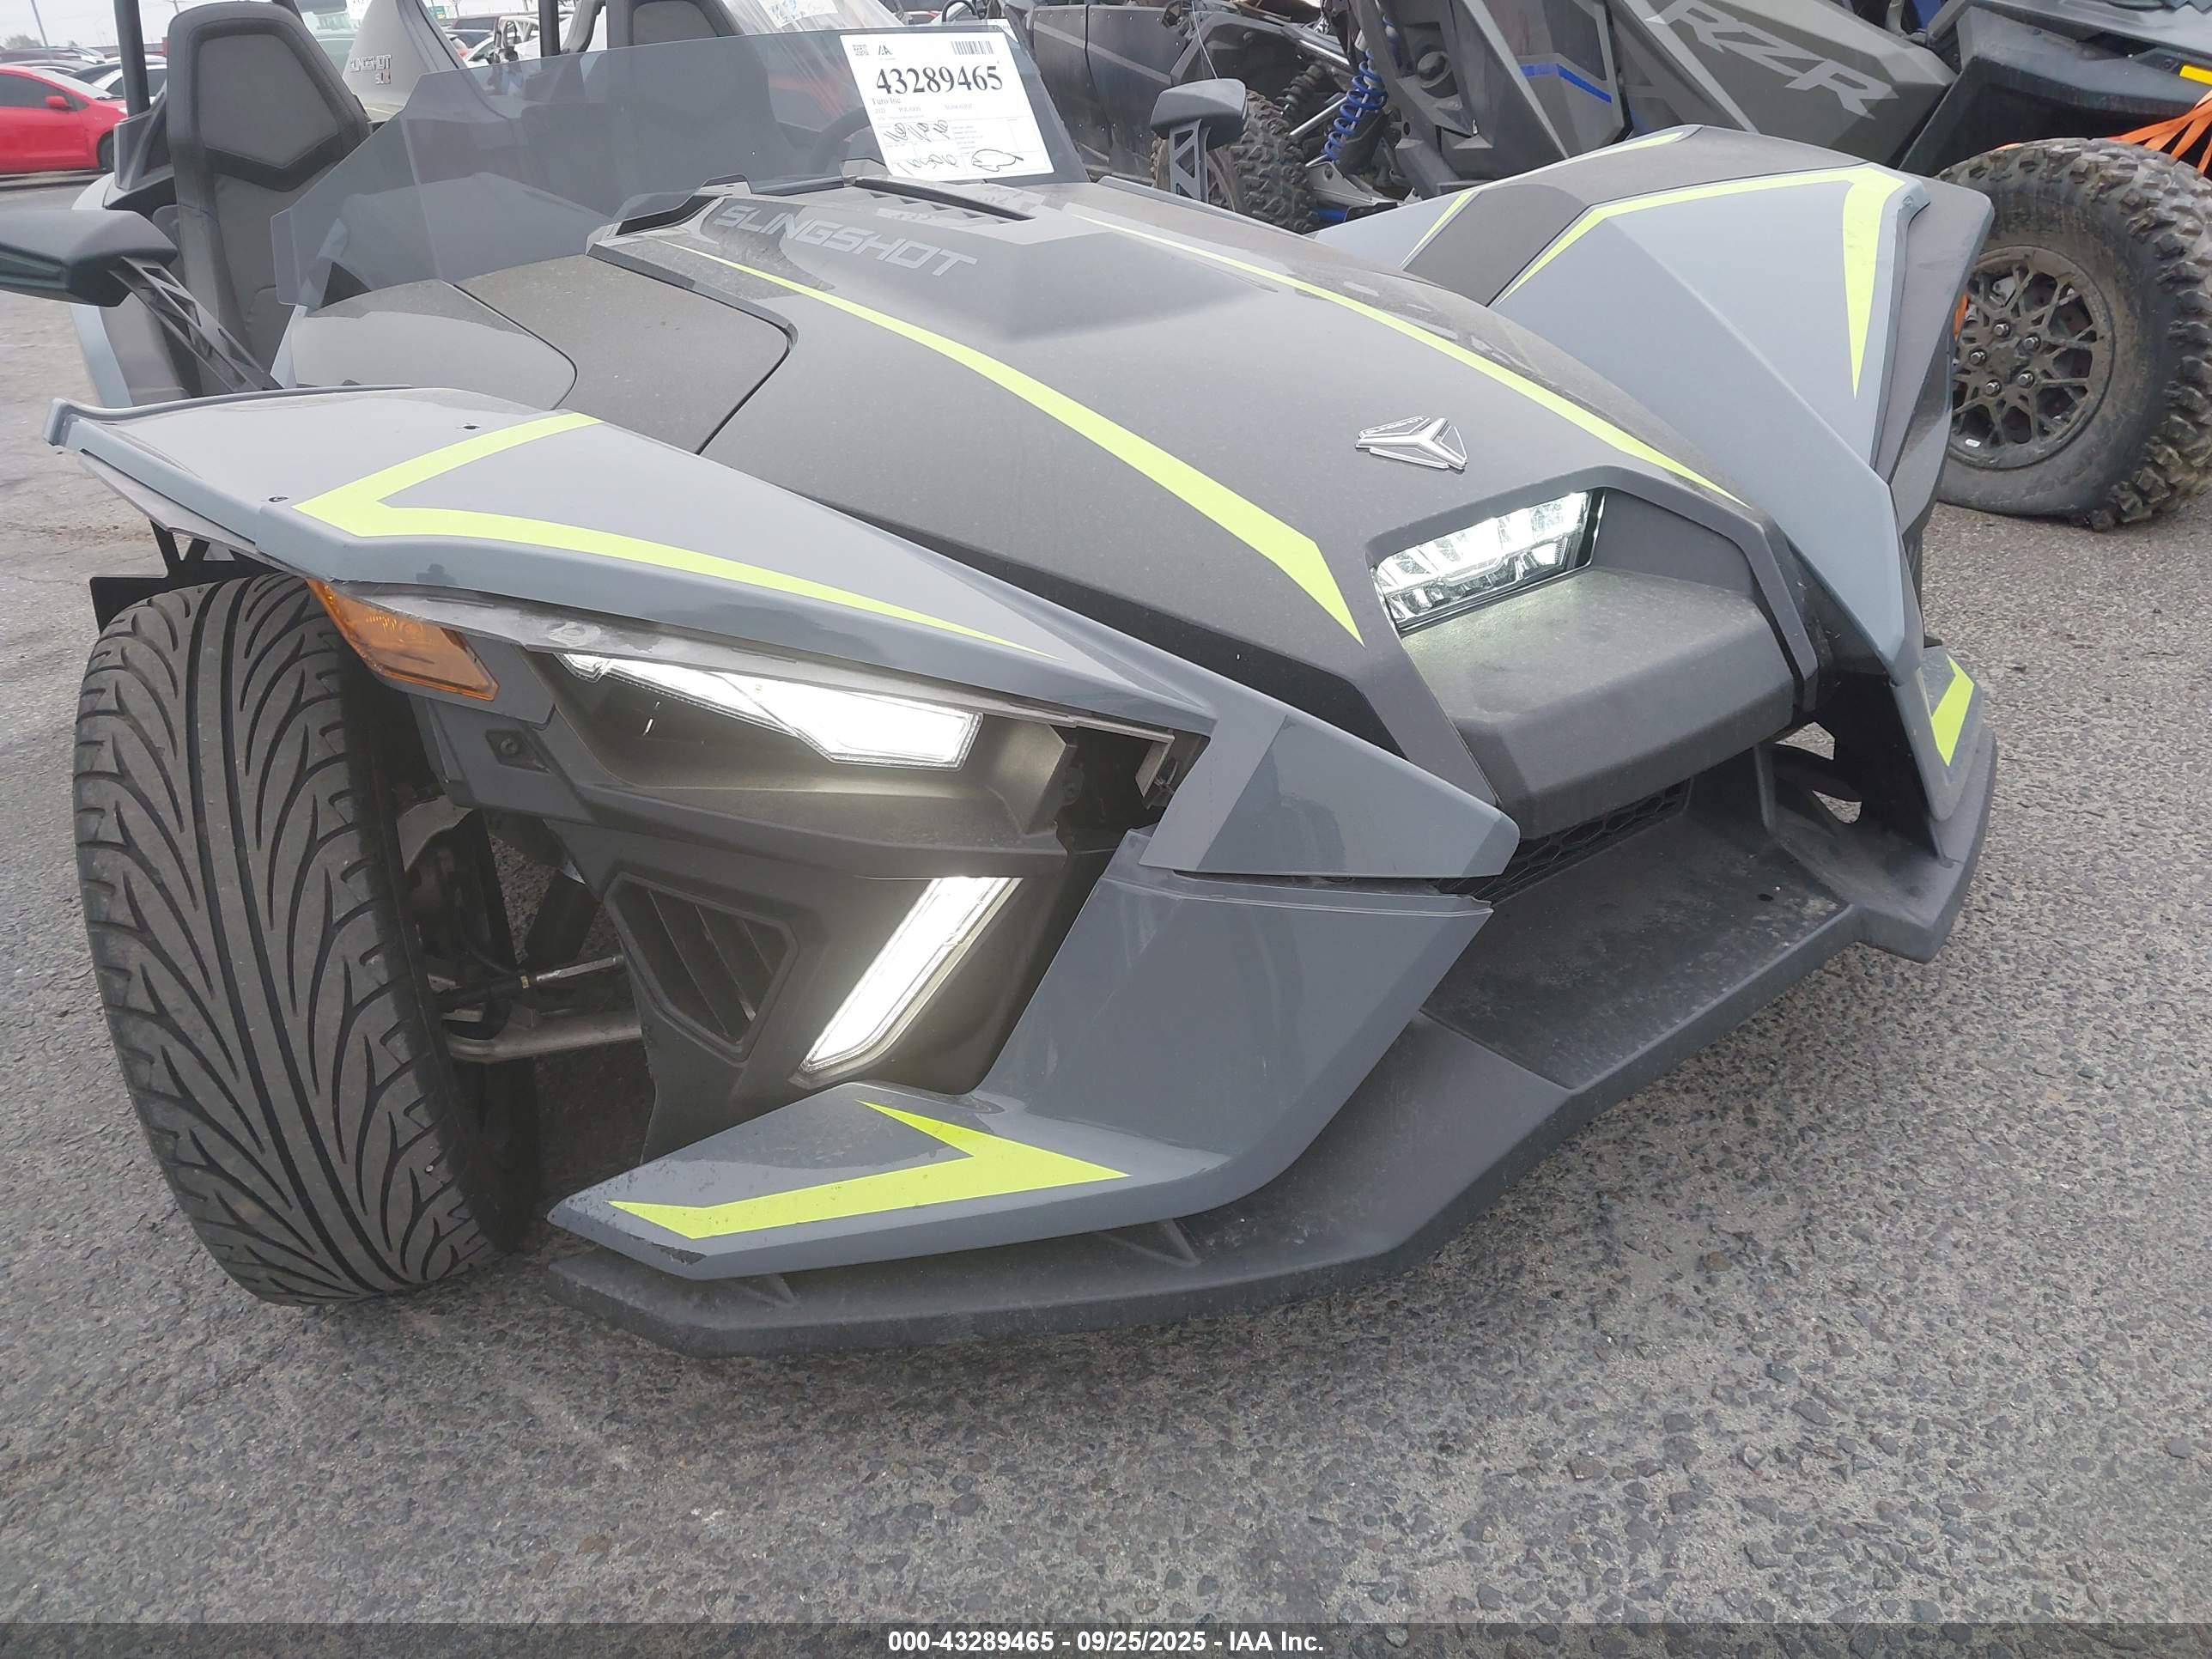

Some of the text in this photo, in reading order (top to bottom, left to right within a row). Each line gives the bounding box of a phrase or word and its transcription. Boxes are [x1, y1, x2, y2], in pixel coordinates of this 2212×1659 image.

[876, 65, 1004, 94] 43289465
[1645, 0, 1900, 120] RZR
[713, 205, 978, 276] SLINGSHOT
